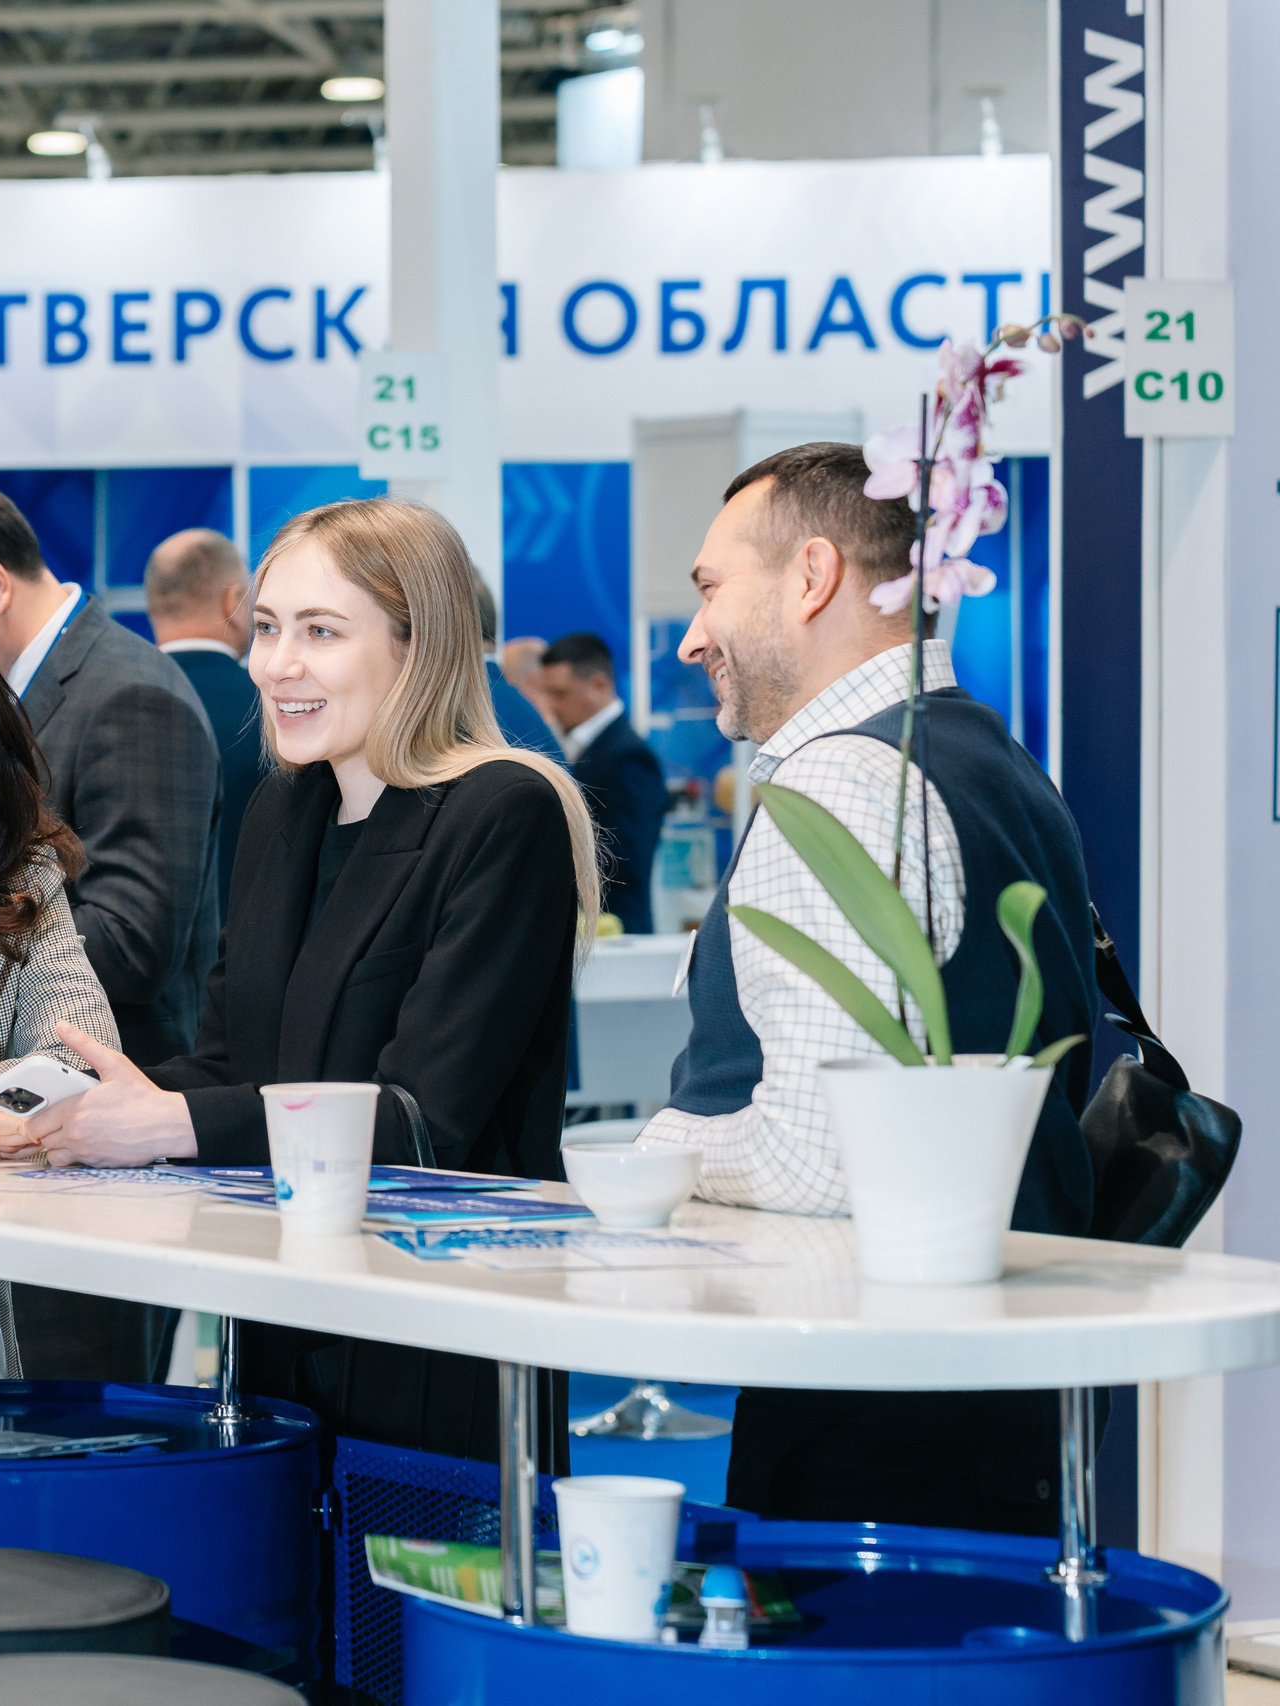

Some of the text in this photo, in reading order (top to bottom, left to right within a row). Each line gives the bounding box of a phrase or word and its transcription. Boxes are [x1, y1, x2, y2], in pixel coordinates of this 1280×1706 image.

[1144, 310, 1196, 342] 21
[374, 374, 416, 402] 21
[1133, 370, 1226, 403] C10
[366, 423, 441, 453] C15
